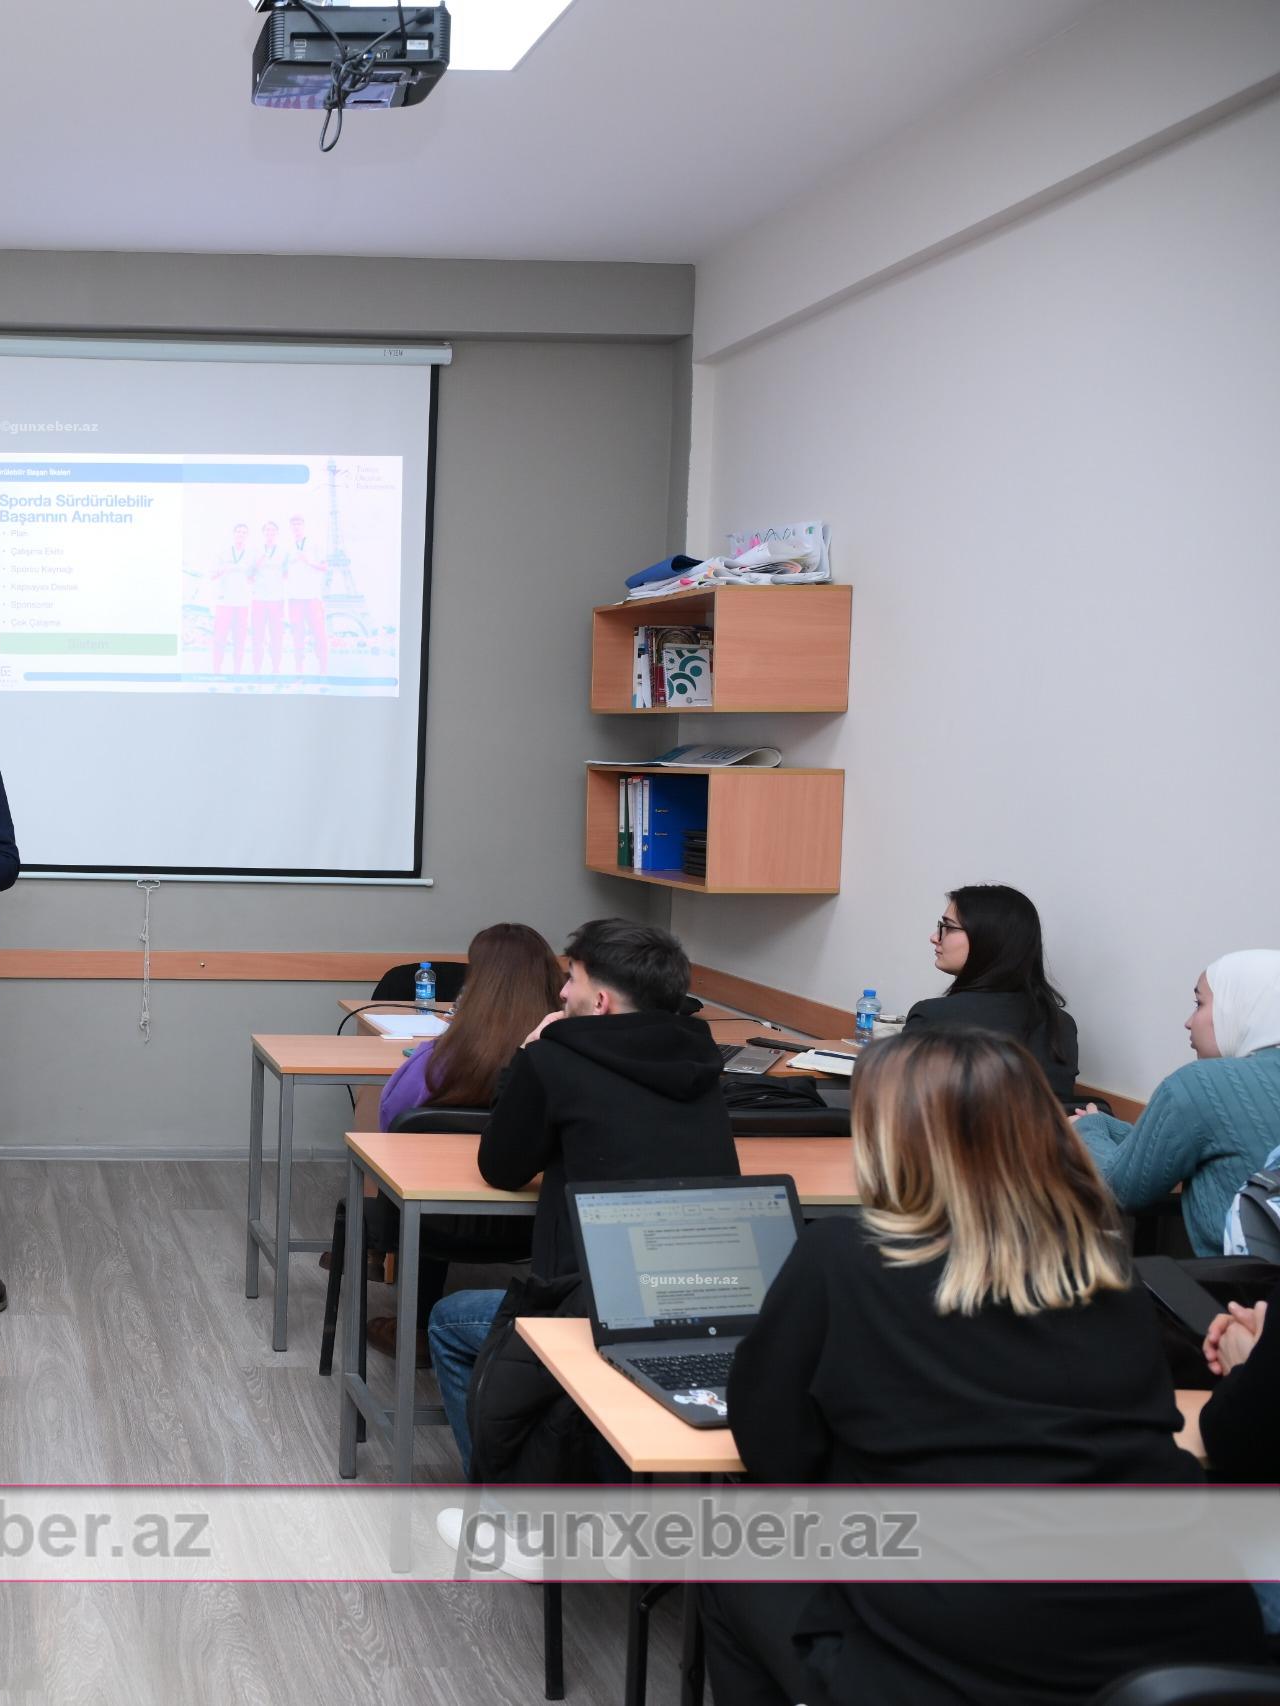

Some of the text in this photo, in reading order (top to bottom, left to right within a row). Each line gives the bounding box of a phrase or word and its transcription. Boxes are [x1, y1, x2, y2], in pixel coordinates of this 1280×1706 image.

[0, 494, 154, 509] Sporda Sürdürülebilir
[0, 510, 133, 525] Başarının Anahtarı
